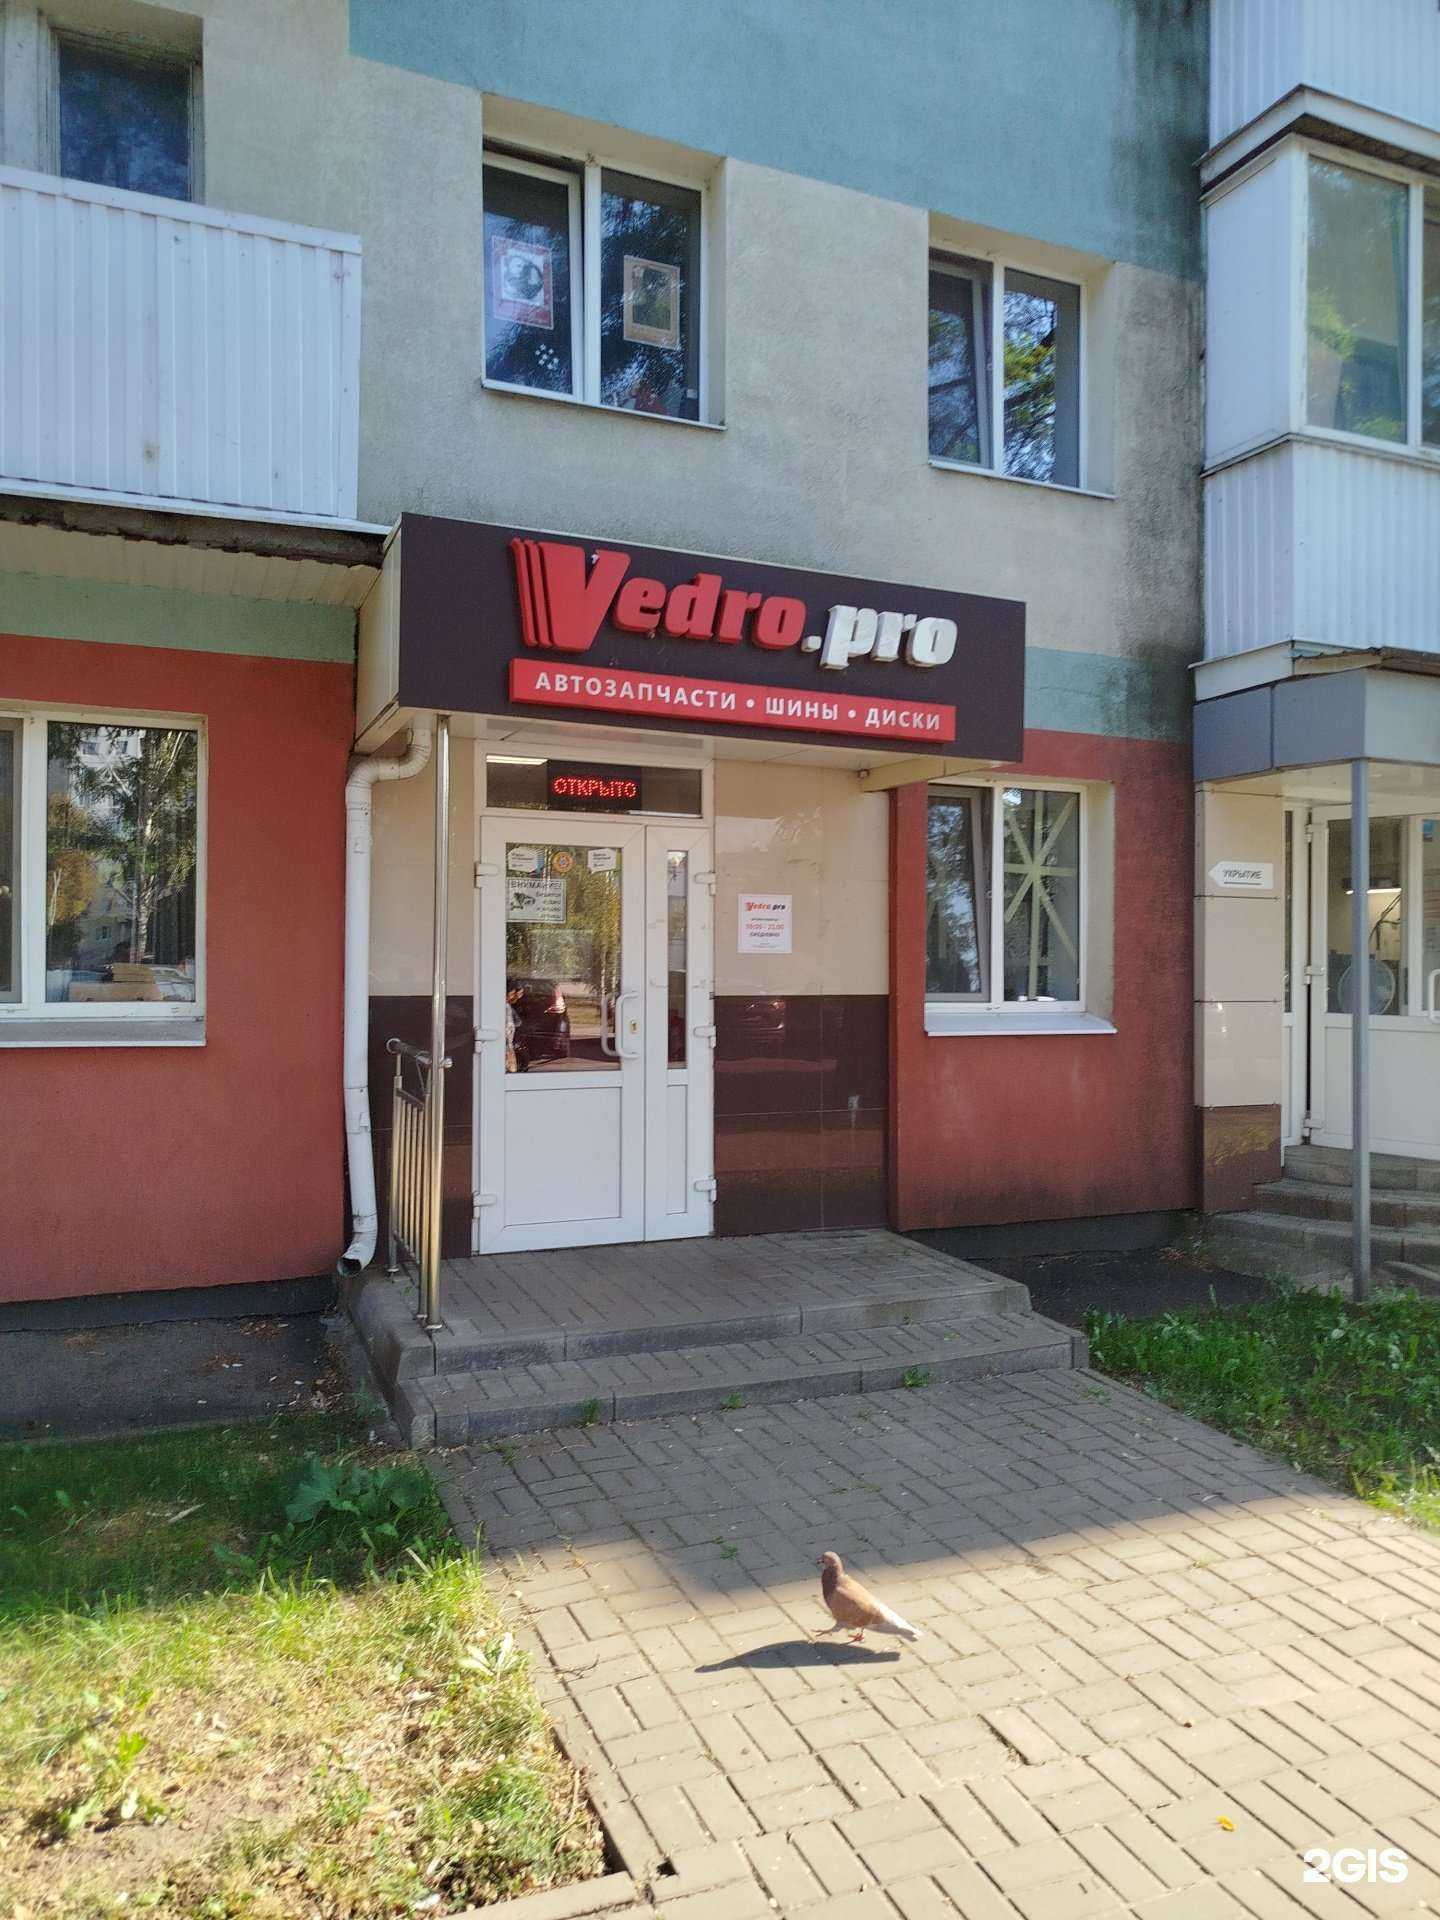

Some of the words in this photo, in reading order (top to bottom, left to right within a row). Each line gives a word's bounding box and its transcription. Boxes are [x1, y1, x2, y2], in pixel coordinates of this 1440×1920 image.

[511, 537, 958, 670] Vedro.pro
[535, 671, 737, 710] АВТОЗАПЧАСТИ
[765, 696, 839, 721] ШИНЫ
[864, 707, 940, 730] ДИСКИ
[554, 777, 637, 798] ОТКРЫТО
